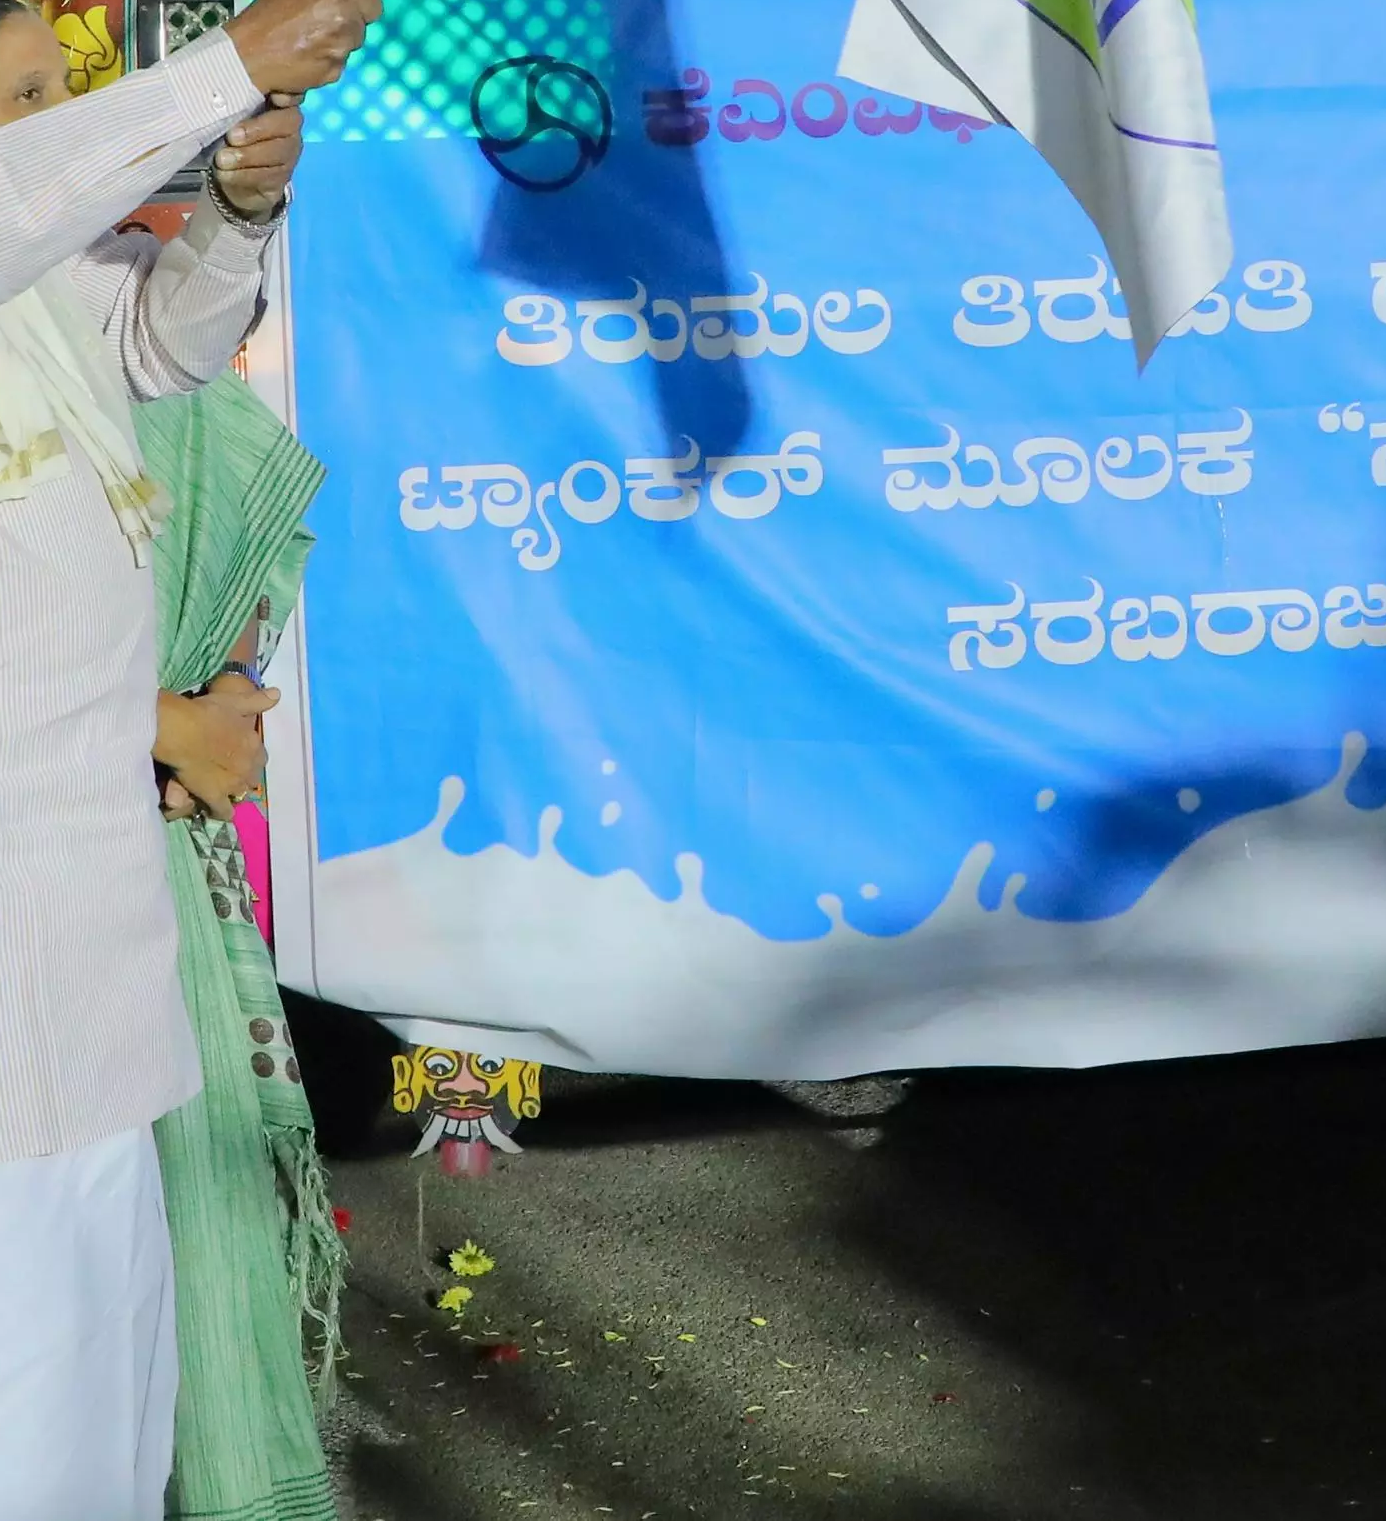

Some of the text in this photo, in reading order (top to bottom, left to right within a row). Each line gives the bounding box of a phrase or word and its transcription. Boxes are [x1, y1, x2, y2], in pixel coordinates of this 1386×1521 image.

[496, 271, 892, 367] ತಿರುಮಲ
[399, 431, 824, 571] ಟ್ಯಾಂಕರ್
[882, 406, 1255, 513] ಮೂಲಕ
